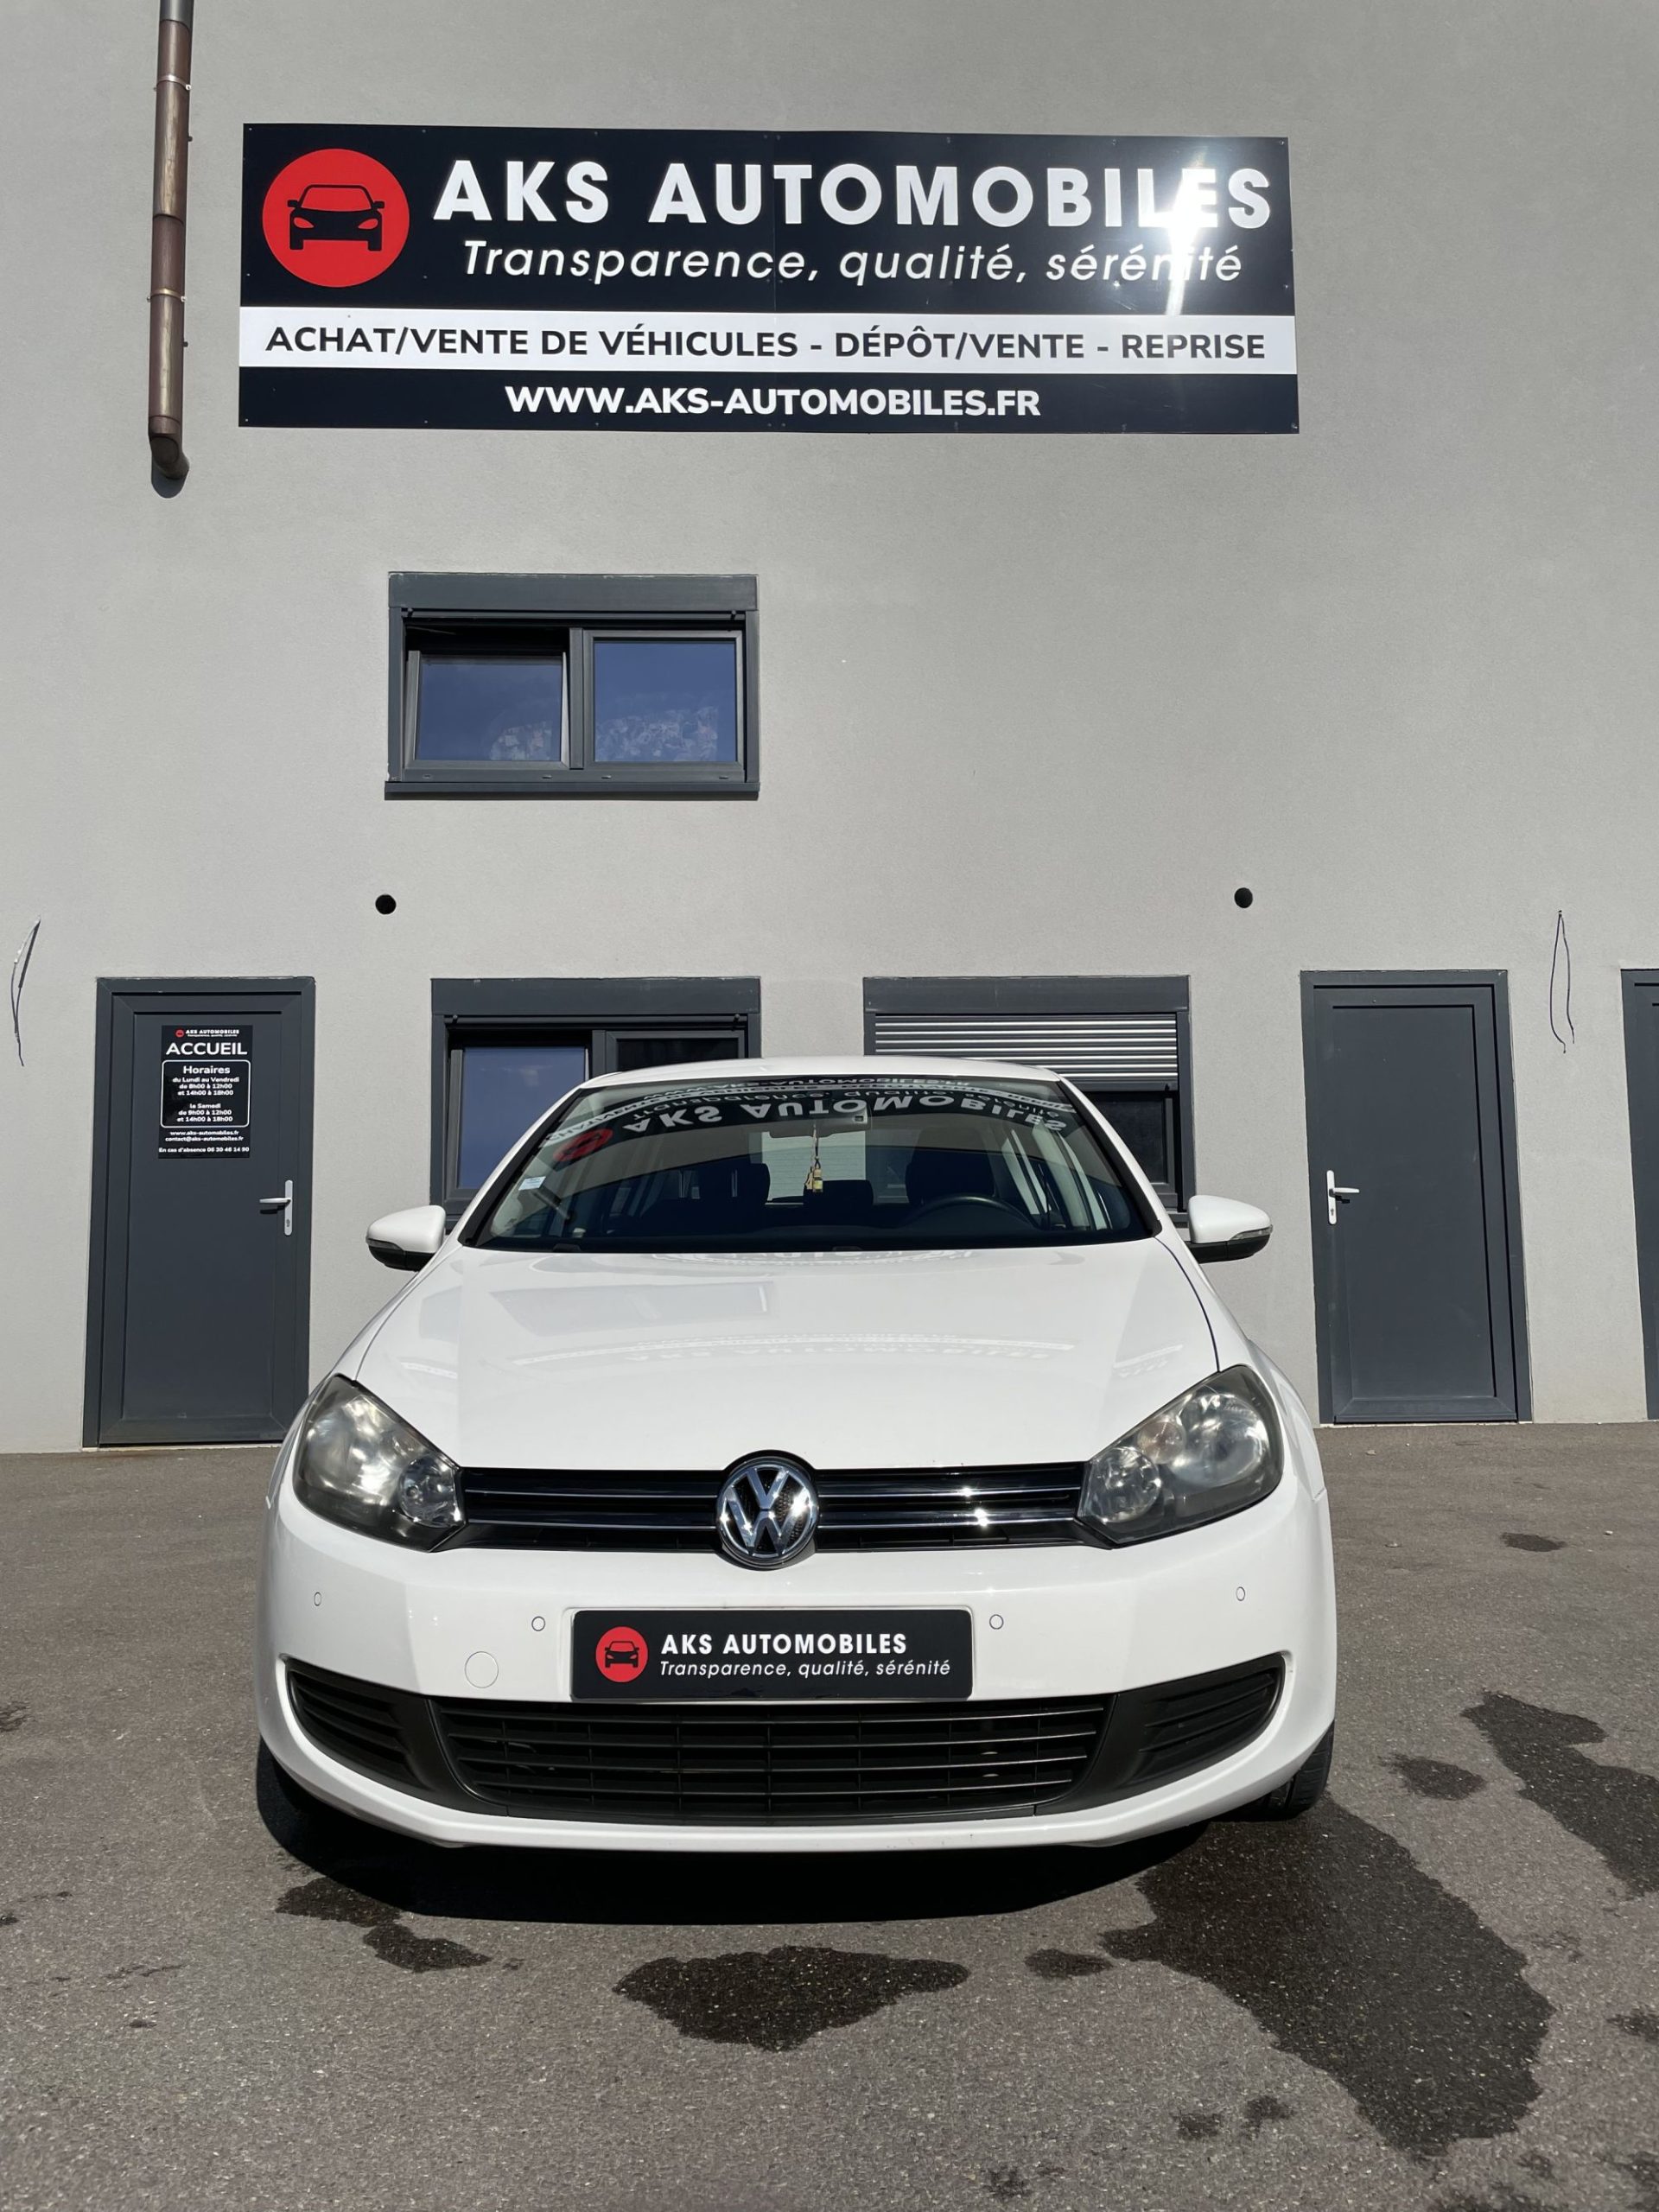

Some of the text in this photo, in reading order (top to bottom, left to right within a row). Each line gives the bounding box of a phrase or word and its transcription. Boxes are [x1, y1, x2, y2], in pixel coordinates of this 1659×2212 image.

[433, 160, 1270, 229] AKS AUTOMOBILES
[463, 240, 1242, 286] Transparence, qualité, sérénité
[265, 327, 528, 355] ACHAT/VENTE
[542, 330, 588, 355] DE
[598, 323, 798, 357] VÉHICULES
[836, 325, 1084, 360] DÉPÔT/VENTE
[1122, 334, 1266, 359] REPRISE
[505, 385, 1041, 416] WWW.AKS-AUTOMOBILES.FR
[166, 1042, 248, 1055] ACCUEIL
[183, 1065, 231, 1074] Horaires
[661, 1633, 907, 1654] AKS AUTOMOBILES
[660, 1660, 950, 1679] Transparence, qualité, sérénité
